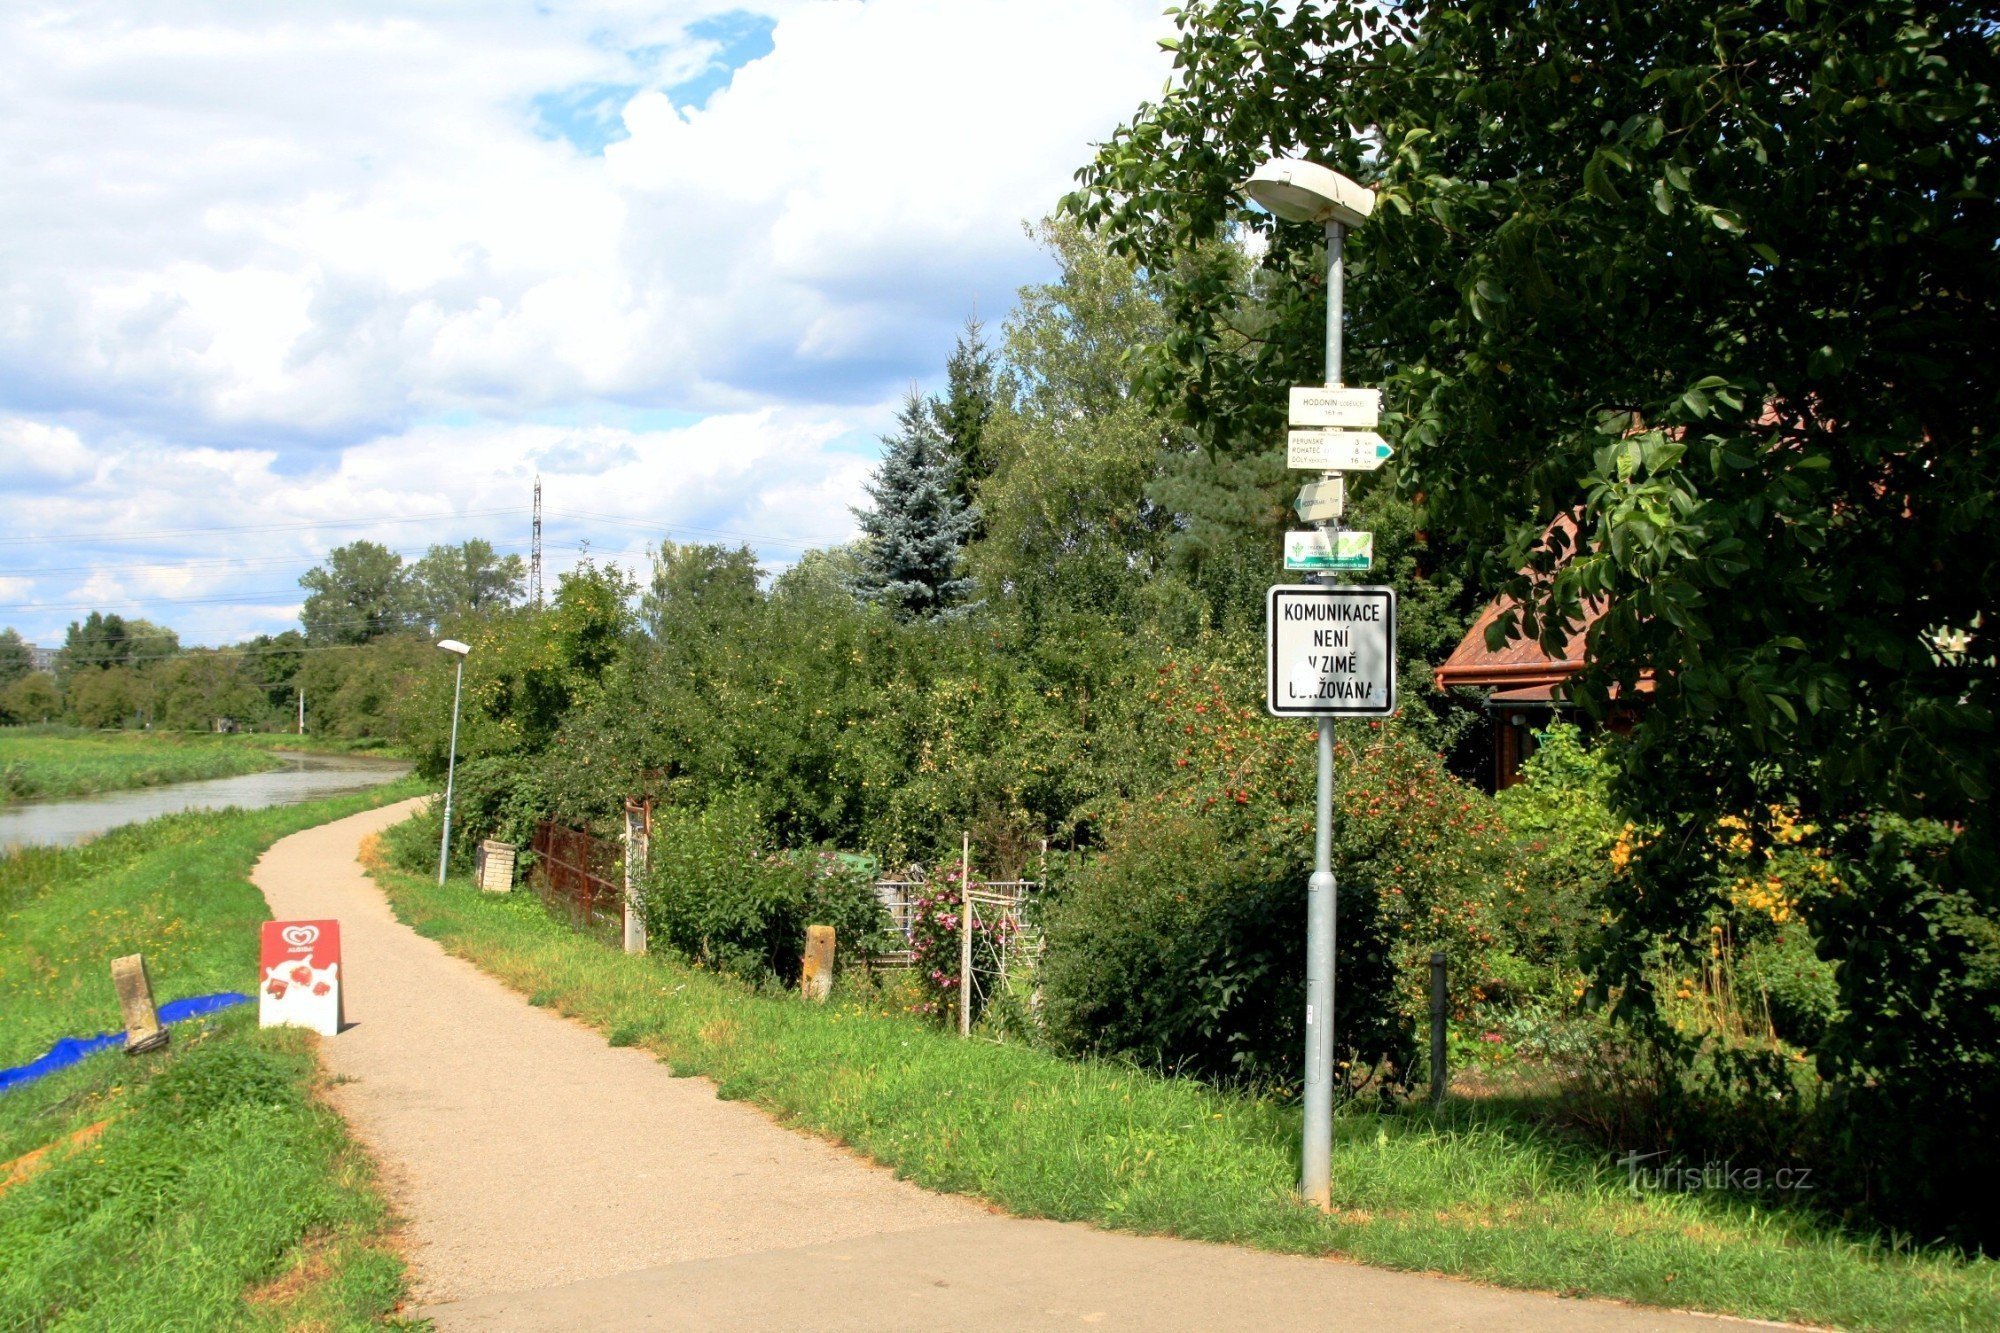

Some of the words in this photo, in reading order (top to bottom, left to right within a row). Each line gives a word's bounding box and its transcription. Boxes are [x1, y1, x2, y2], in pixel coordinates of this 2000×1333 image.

[1284, 603, 1380, 622] KOMUNIKACE
[1314, 626, 1350, 647] NENÍ
[1308, 655, 1317, 670] V
[1321, 651, 1357, 674] ZIMĚ
[1289, 676, 1373, 699] UŽOVÁNA
